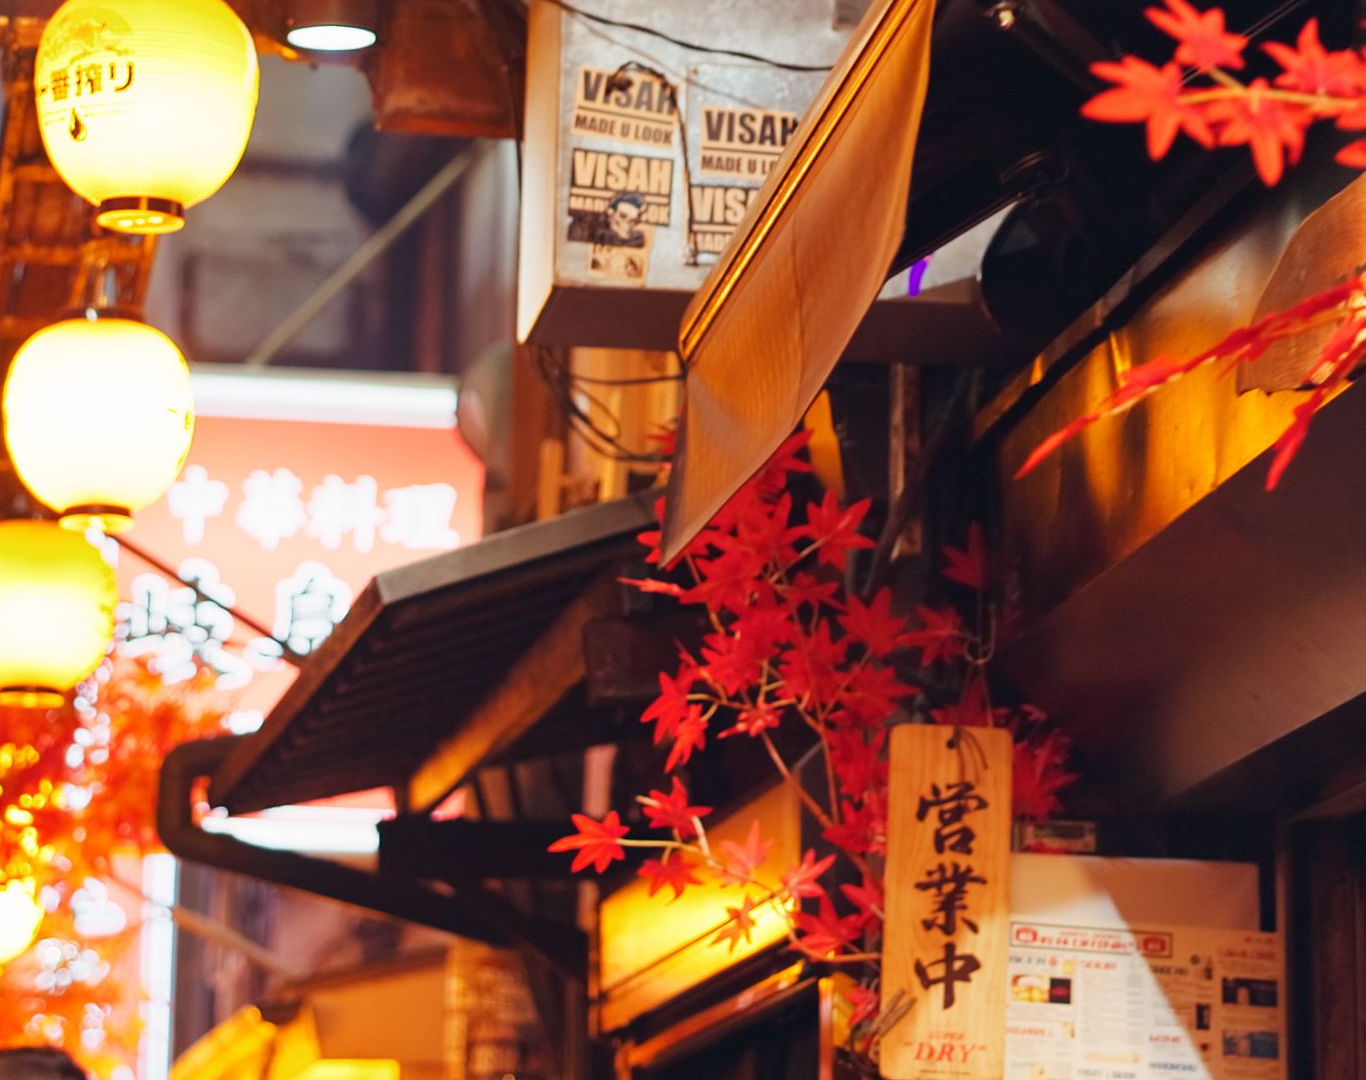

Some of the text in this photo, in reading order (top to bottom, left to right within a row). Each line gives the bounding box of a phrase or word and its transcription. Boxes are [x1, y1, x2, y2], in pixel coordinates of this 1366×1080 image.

[574, 115, 673, 145] MADE U LOOK
[573, 149, 673, 195] VISAH
[701, 154, 743, 172] MADE
[747, 158, 757, 174] U
[915, 780, 989, 1010] 営業中
